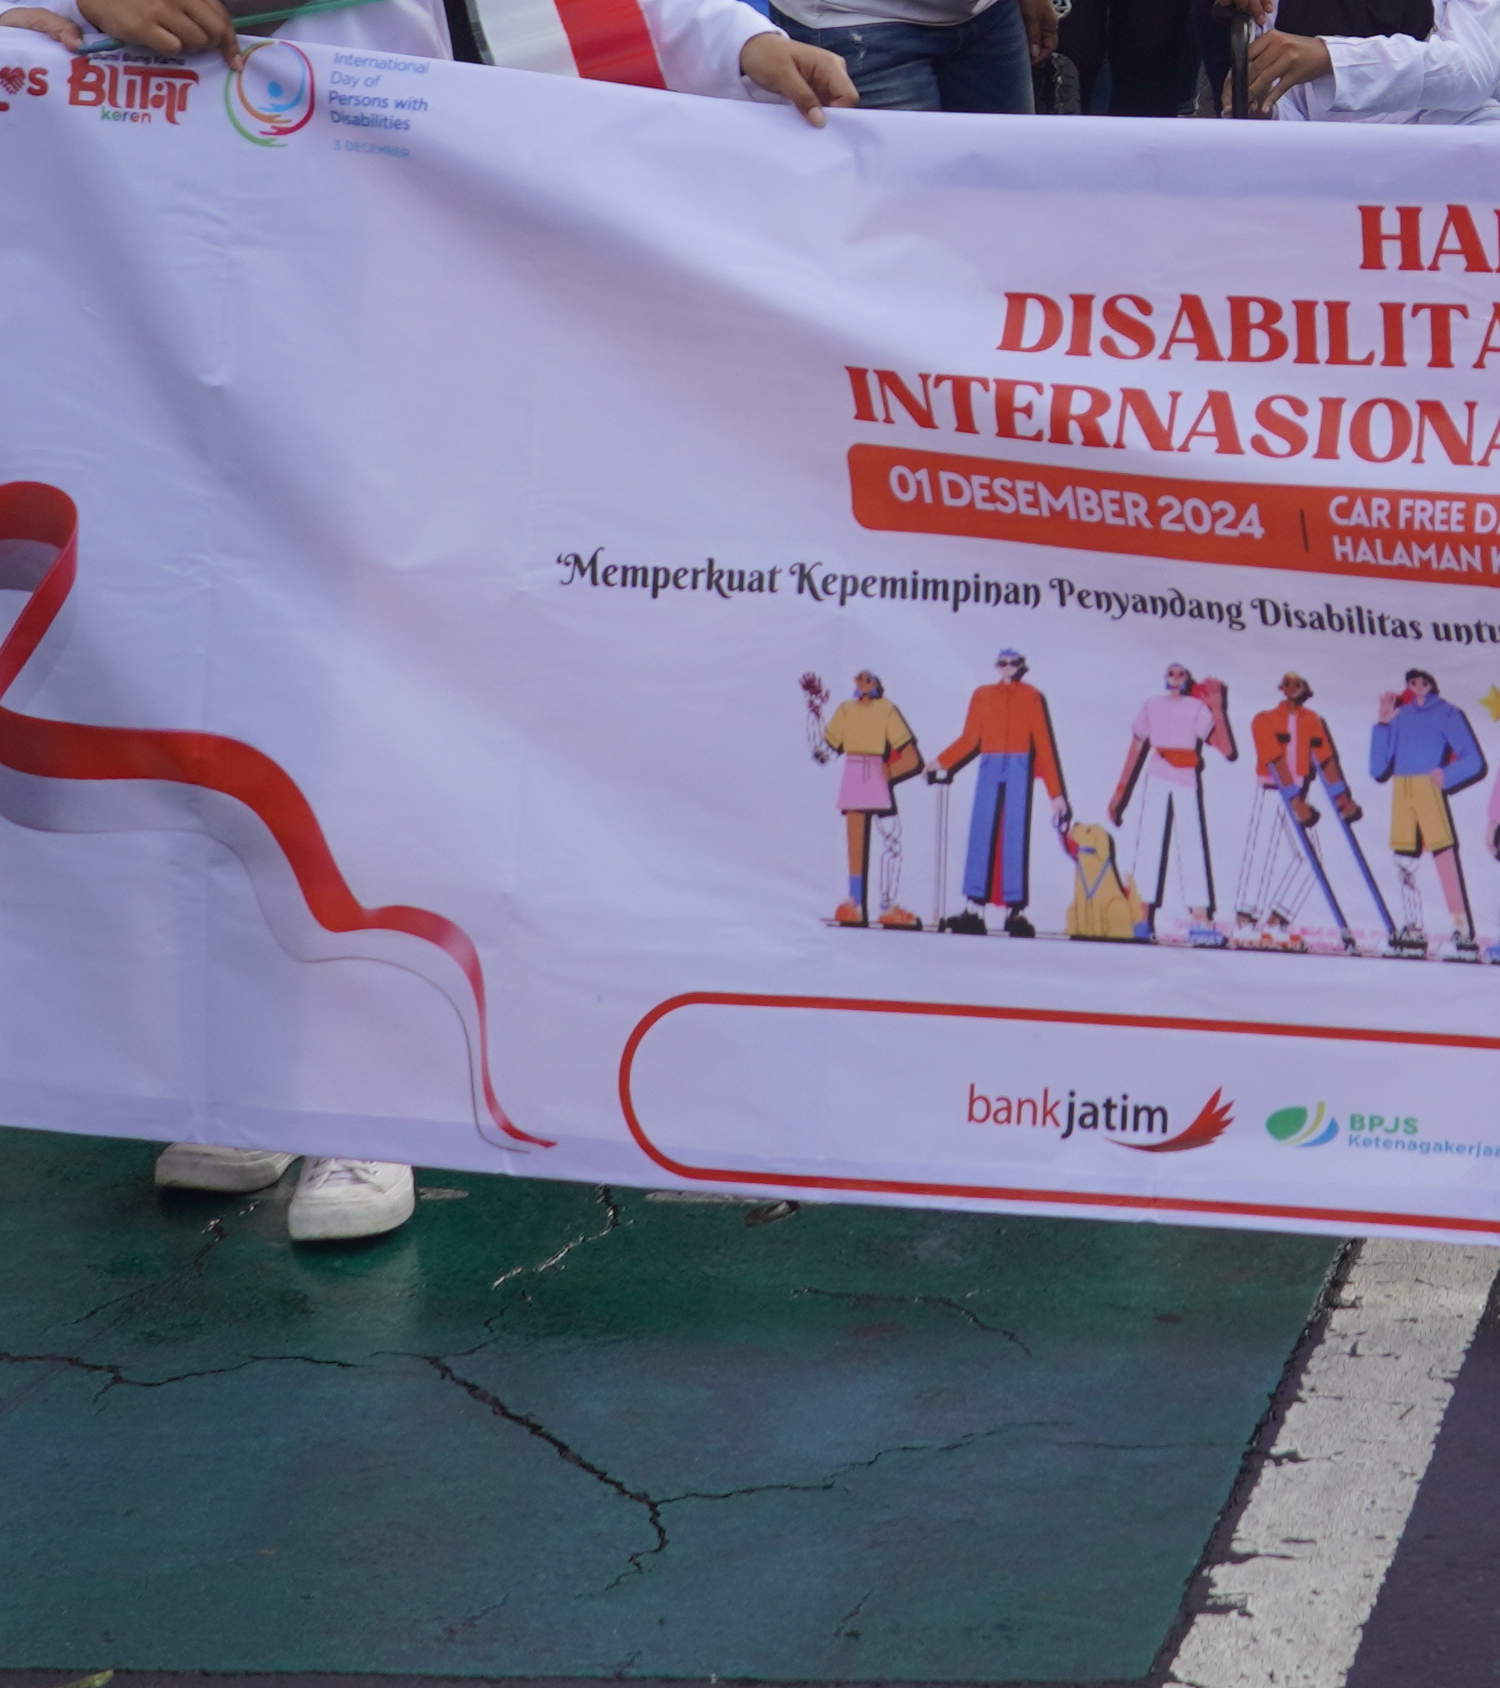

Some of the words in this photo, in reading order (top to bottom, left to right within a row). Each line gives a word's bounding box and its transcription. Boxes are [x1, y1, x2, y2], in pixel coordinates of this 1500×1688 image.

[330, 70, 360, 89] Day
[363, 73, 382, 87] of
[334, 52, 430, 74] International
[329, 90, 389, 109] Persons
[394, 95, 429, 112] with
[330, 109, 410, 131] Disabilities
[888, 463, 934, 506] 01
[939, 466, 1153, 532] DESEMBER
[1156, 491, 1267, 541] 2024
[1327, 494, 1391, 532] CAR
[1397, 496, 1465, 536] FREE
[1331, 535, 1484, 576] HALAMAN
[789, 559, 1042, 610] Kepemimpinan
[1049, 574, 1247, 632] Penyandang
[1250, 594, 1424, 642] Disabilitas
[967, 1083, 1170, 1139] bankjatim
[1349, 1112, 1420, 1137] BPJS
